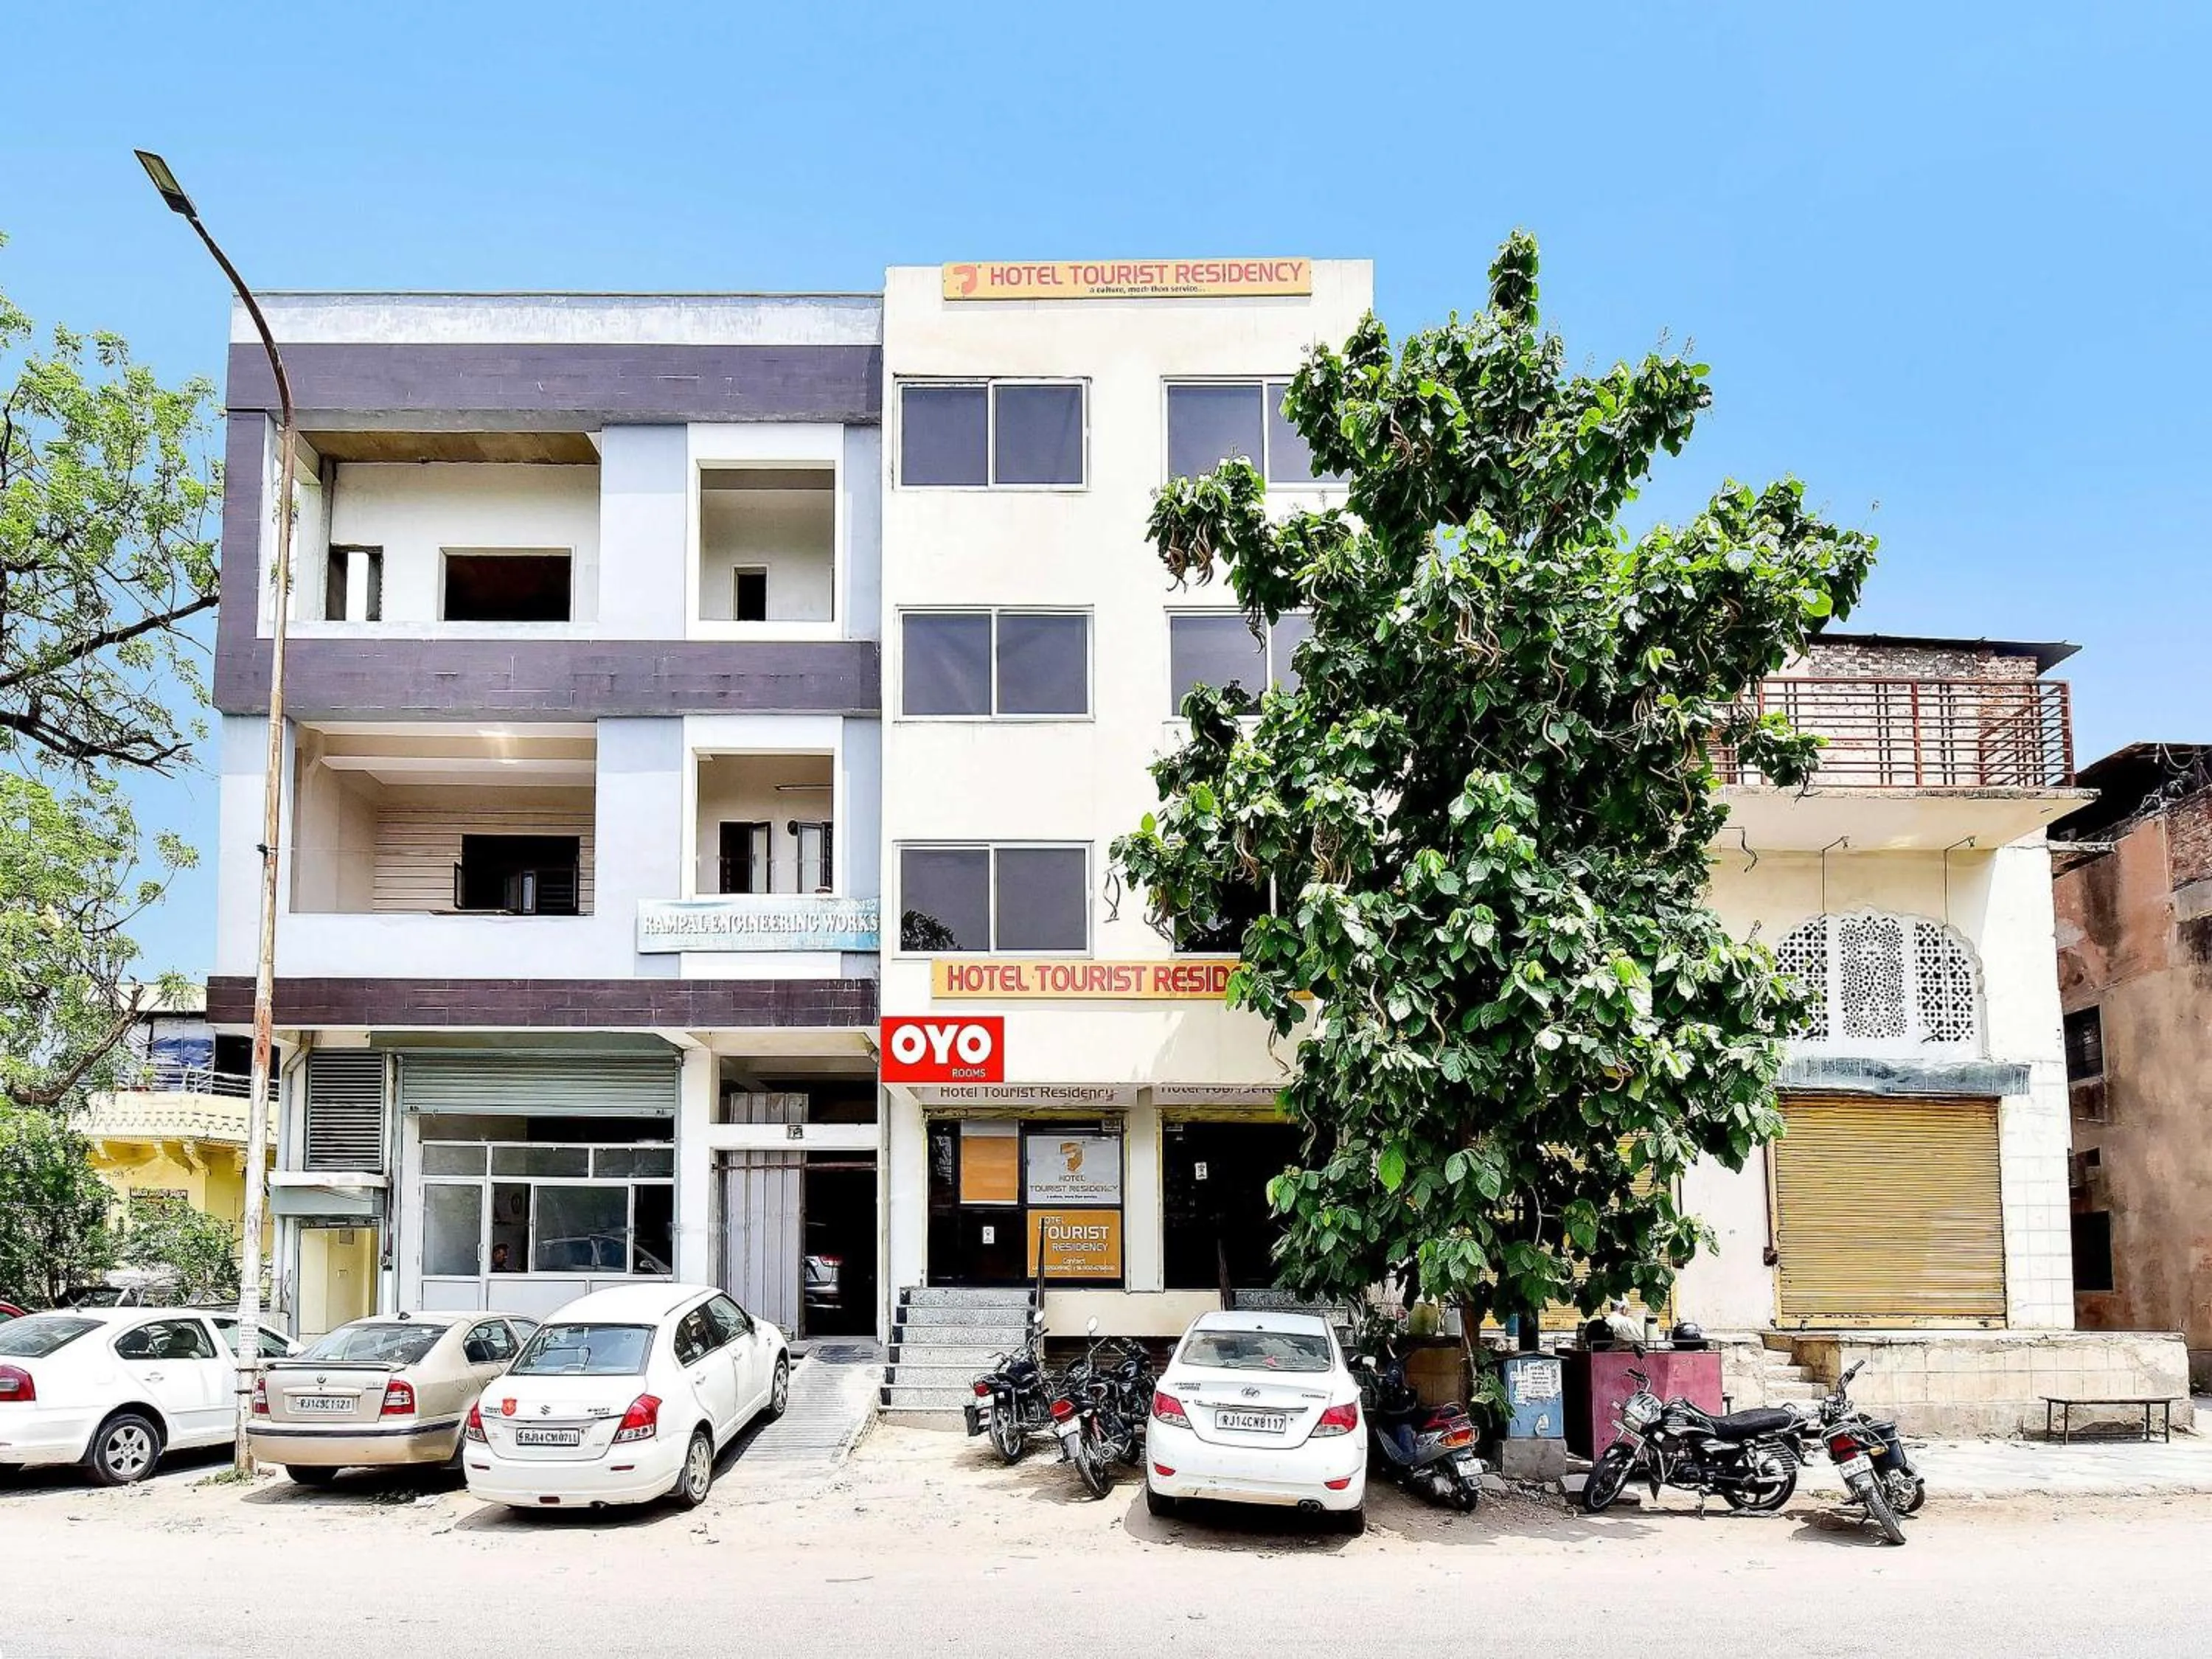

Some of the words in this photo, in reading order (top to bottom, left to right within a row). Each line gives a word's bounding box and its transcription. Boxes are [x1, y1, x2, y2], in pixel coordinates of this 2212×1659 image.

[990, 265, 1063, 286] HOTEL
[1069, 263, 1169, 285] TOURIST
[1175, 262, 1303, 283] RESIDENCY
[824, 913, 879, 933] WORKS
[947, 965, 1029, 992] HOTEL
[1034, 965, 1147, 992] TOURIST
[1153, 965, 1242, 992] RESID
[891, 1023, 992, 1064] OYO
[952, 1068, 986, 1078] ROOMS
[940, 1087, 977, 1098] Hotel
[981, 1087, 1035, 1098] Tourist
[1040, 1087, 1116, 1102] Residency
[1052, 1242, 1109, 1252] RESIDENCY
